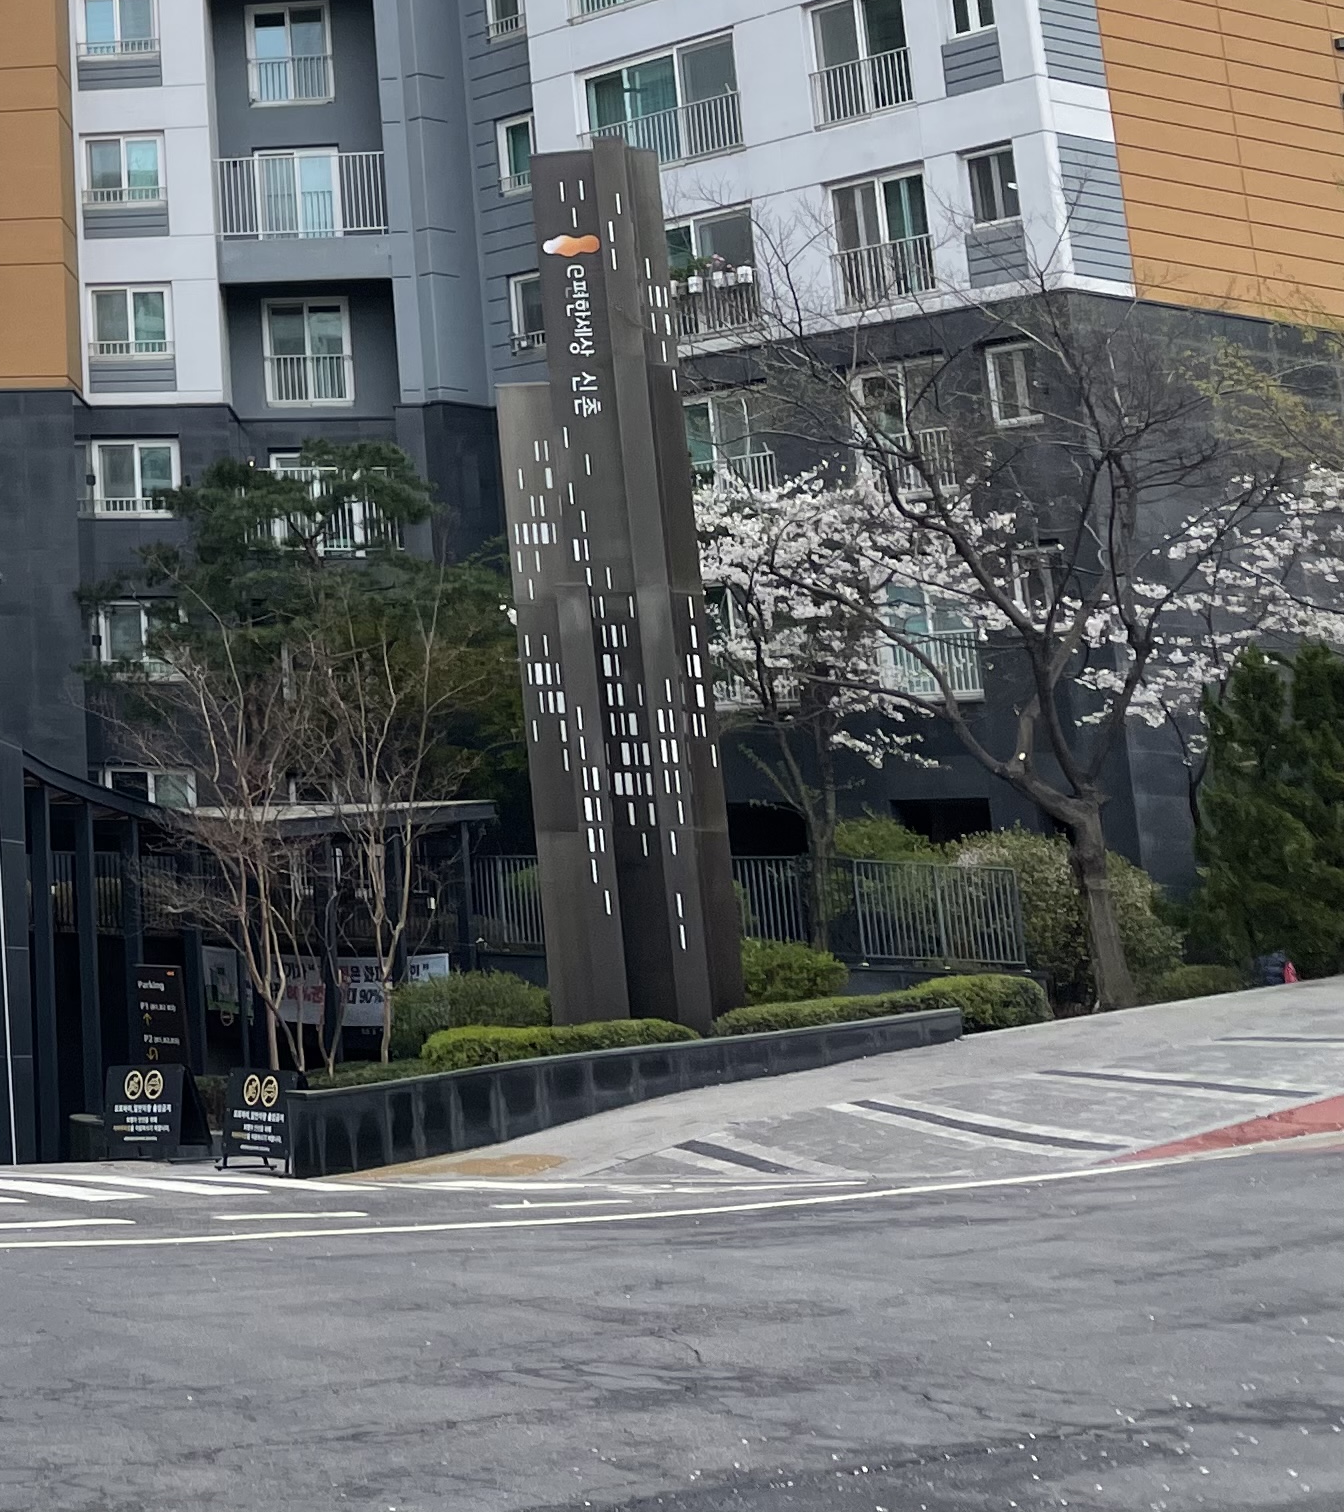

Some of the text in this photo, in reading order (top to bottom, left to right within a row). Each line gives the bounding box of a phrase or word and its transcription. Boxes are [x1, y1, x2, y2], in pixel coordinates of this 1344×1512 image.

[566, 264, 601, 418] e편한세상 신촌
[137, 980, 165, 992] Parking
